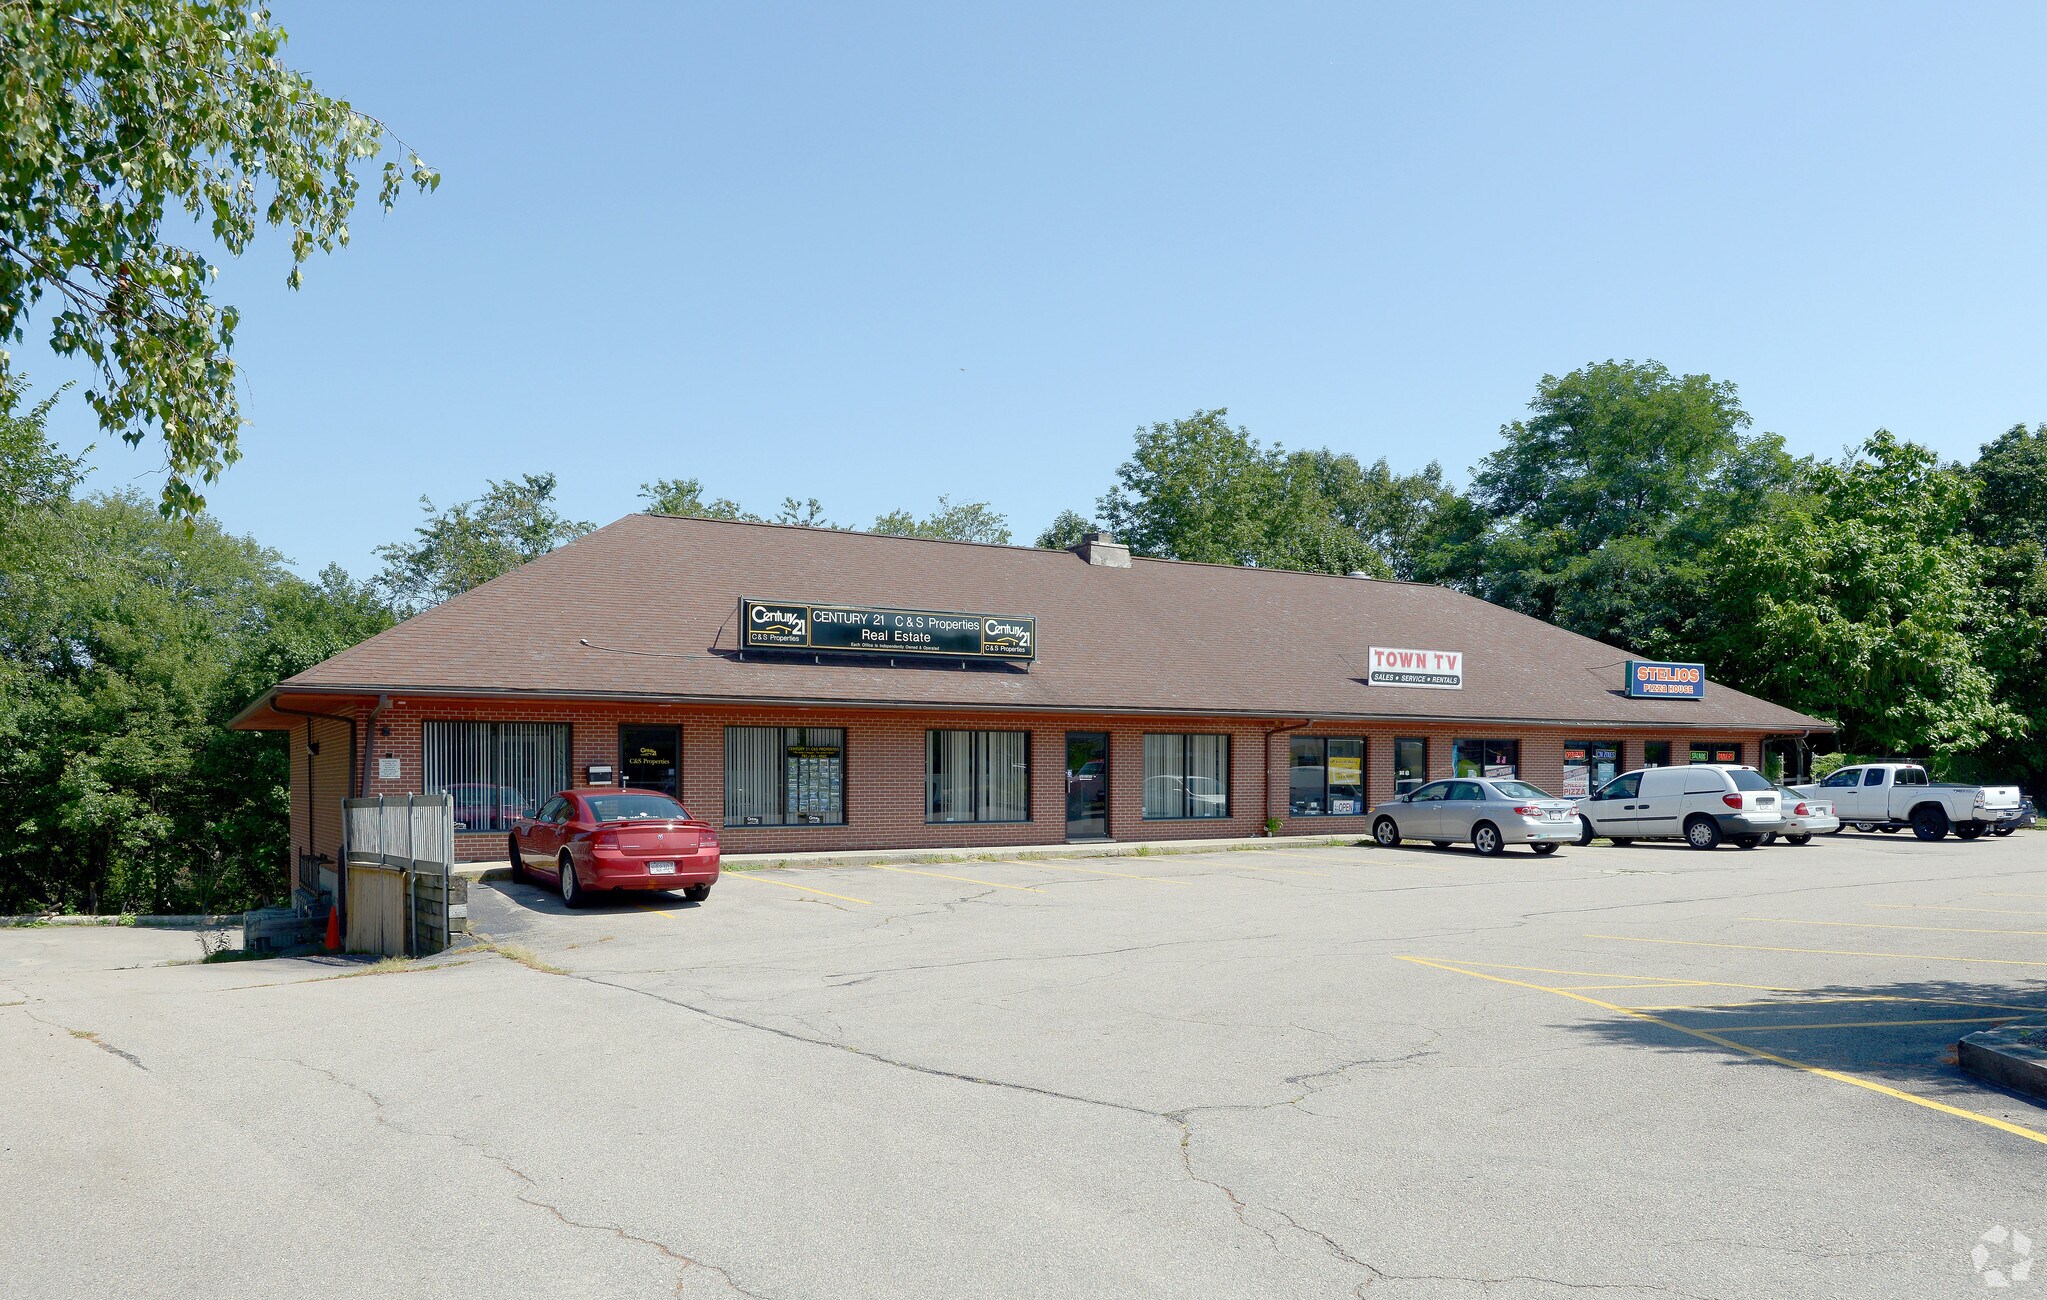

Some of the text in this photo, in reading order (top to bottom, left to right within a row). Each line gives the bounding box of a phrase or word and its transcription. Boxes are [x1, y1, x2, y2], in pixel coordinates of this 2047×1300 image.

[752, 606, 805, 635] Century 21
[813, 611, 868, 624] CENTURY
[873, 614, 884, 625] 21
[928, 617, 980, 631] Properties
[770, 634, 800, 642] Properties
[862, 629, 931, 642] Real Estate
[985, 620, 1030, 646] Century 21
[1001, 645, 1026, 653] Properties
[1375, 650, 1457, 671] TOWN TV
[1374, 673, 1458, 684] SALES SERVICE RENTALS
[1637, 666, 1700, 683] STELIOS
[1668, 684, 1693, 694] HOUSE
[643, 758, 670, 766] Properties
[1564, 788, 1586, 796] PIZZA
[1339, 802, 1353, 812] OPEN
